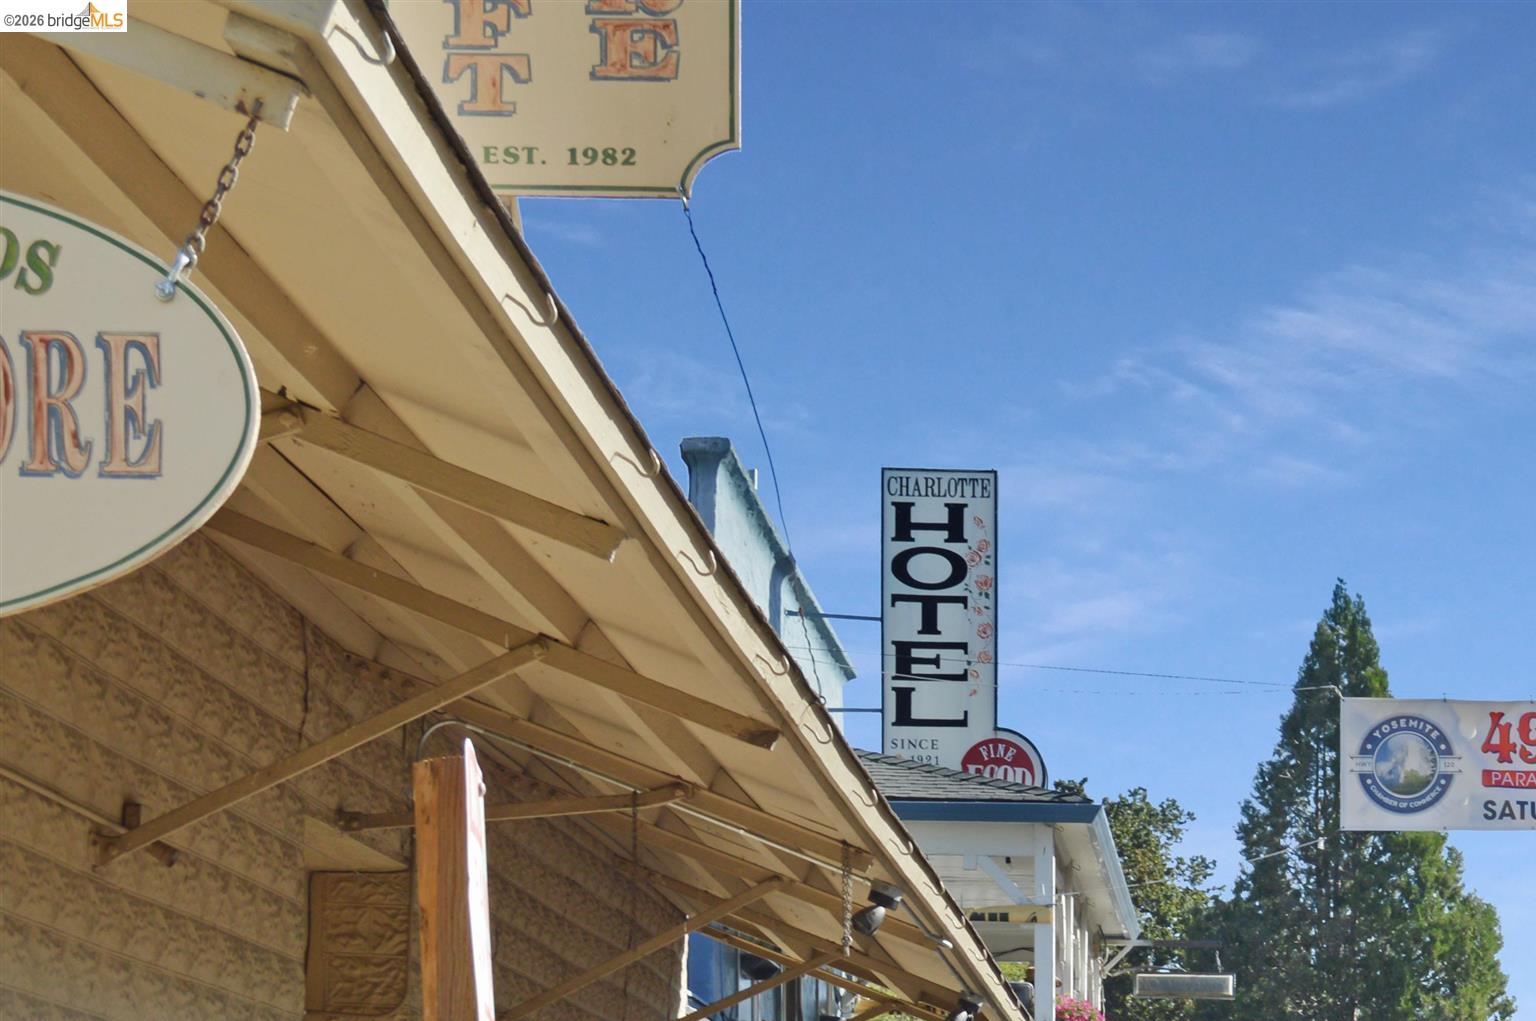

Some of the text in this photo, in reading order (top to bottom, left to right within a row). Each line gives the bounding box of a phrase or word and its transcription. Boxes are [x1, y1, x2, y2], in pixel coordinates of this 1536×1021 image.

[483, 146, 637, 166] EST. 1982
[0, 330, 163, 480] RE
[887, 476, 990, 498] CHARLOTTE
[891, 501, 968, 727] HOTEL
[1373, 719, 1440, 739] YOSEMITE
[891, 738, 938, 750] SINCE
[979, 743, 1016, 761] FINE
[911, 754, 939, 766] 1921
[966, 764, 1034, 786] FOOD
[1370, 784, 1398, 807] CHAMBER
[1398, 799, 1408, 808] OF
